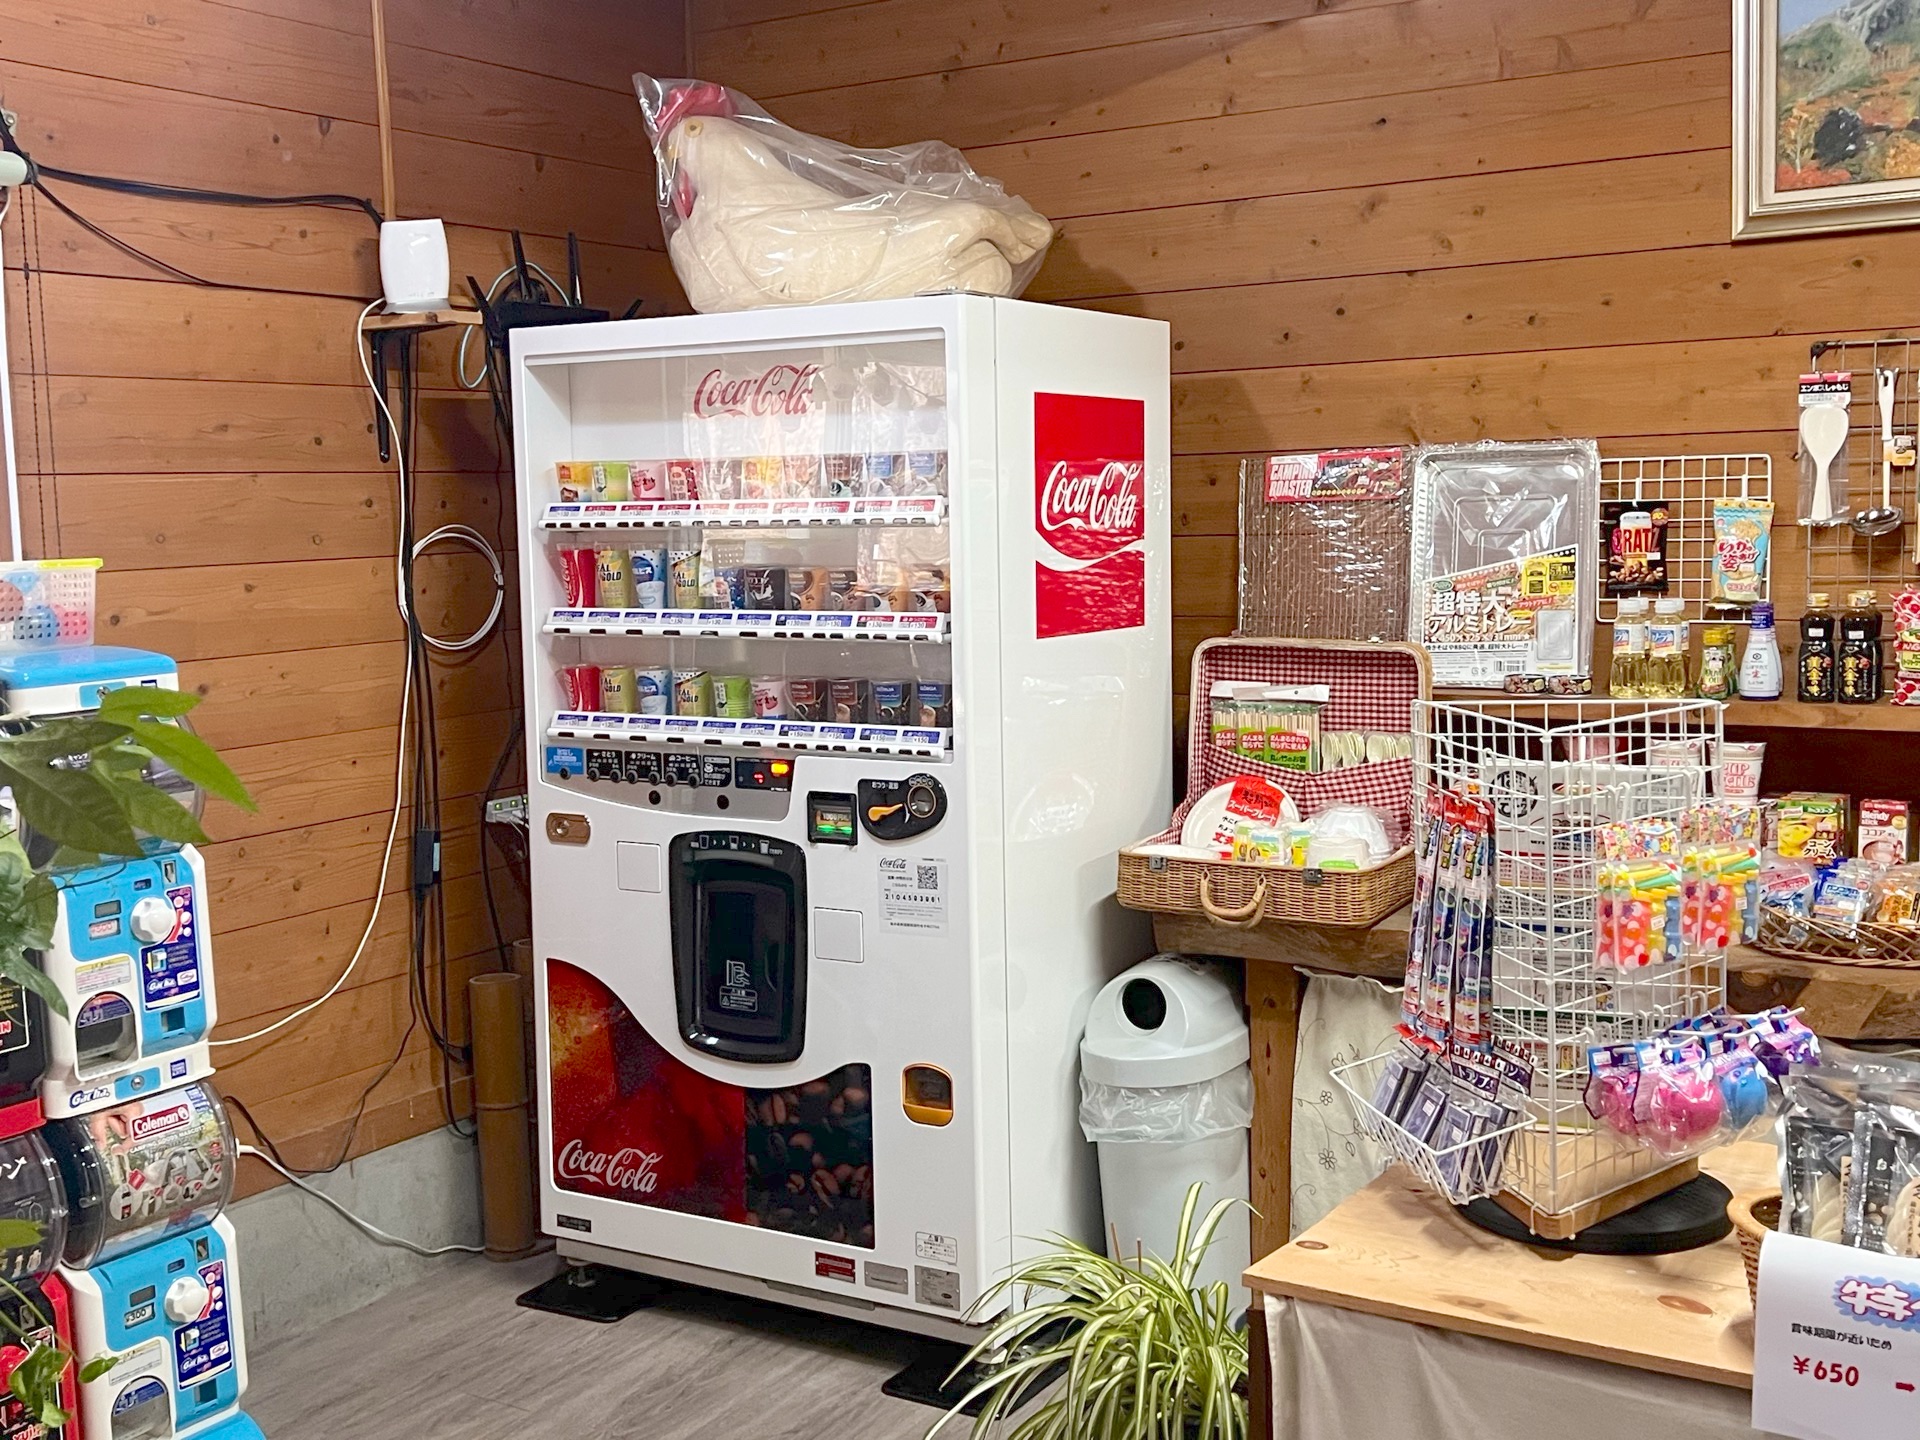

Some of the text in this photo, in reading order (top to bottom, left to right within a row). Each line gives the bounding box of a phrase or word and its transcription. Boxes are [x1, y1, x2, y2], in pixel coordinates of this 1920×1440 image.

[694, 363, 819, 419] Coca-Cola
[1040, 460, 1142, 531] Coca-Cola
[1269, 480, 1313, 498] ROASTER
[1431, 590, 1506, 615] 超特大
[1429, 614, 1532, 633] アルミトレー
[1861, 810, 1890, 821] Blendy
[133, 1112, 179, 1135] Coleman
[557, 1138, 664, 1194] Coca-Cola
[1839, 1279, 1920, 1322] 特
[125, 1308, 147, 1323] ¥300
[1791, 1322, 1893, 1351] 賞味期限が近いため
[1793, 1354, 1860, 1387] ¥650
